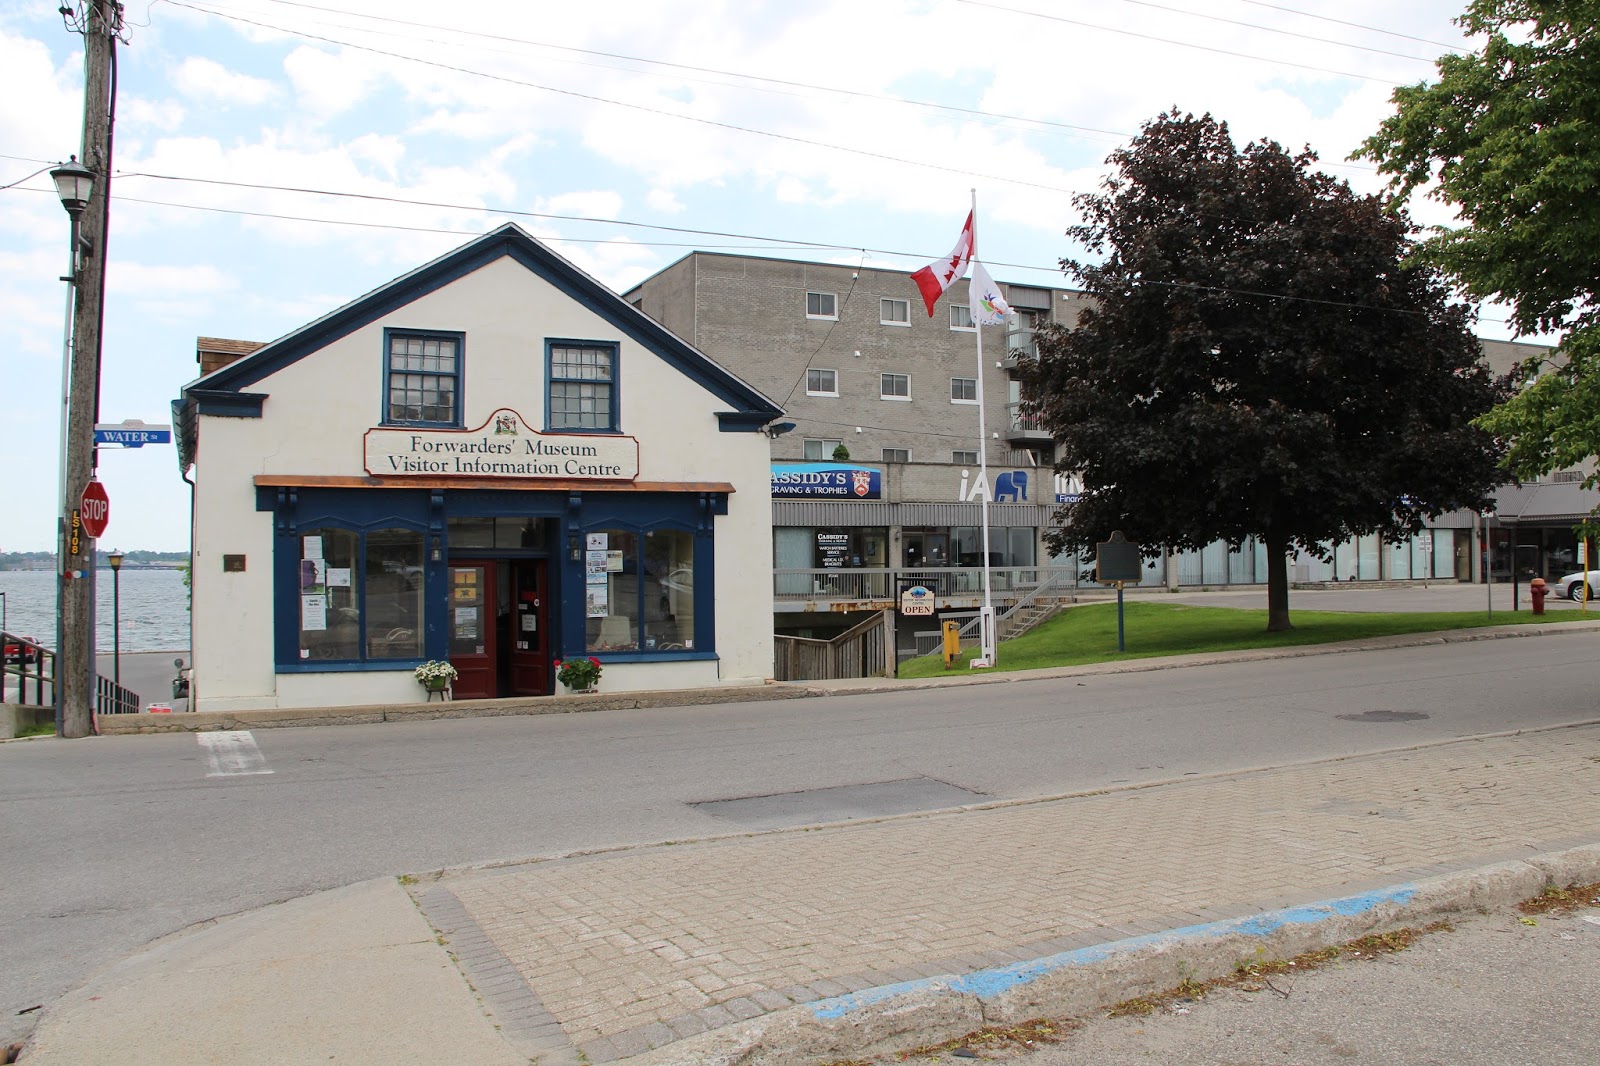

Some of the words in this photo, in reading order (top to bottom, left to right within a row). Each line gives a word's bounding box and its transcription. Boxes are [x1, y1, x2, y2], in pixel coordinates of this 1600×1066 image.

[103, 431, 149, 442] WATER
[410, 436, 516, 454] Forwarders'
[525, 439, 598, 457] Museum
[388, 455, 449, 472] Visitor
[455, 457, 559, 475] Information
[564, 459, 621, 476] Centre
[771, 471, 847, 485] ASSIDY'S
[1054, 473, 1085, 494] Inv
[771, 486, 803, 494] GRAVING
[805, 486, 811, 494] &
[813, 486, 848, 495] TROPHIES
[83, 498, 108, 521] STOP
